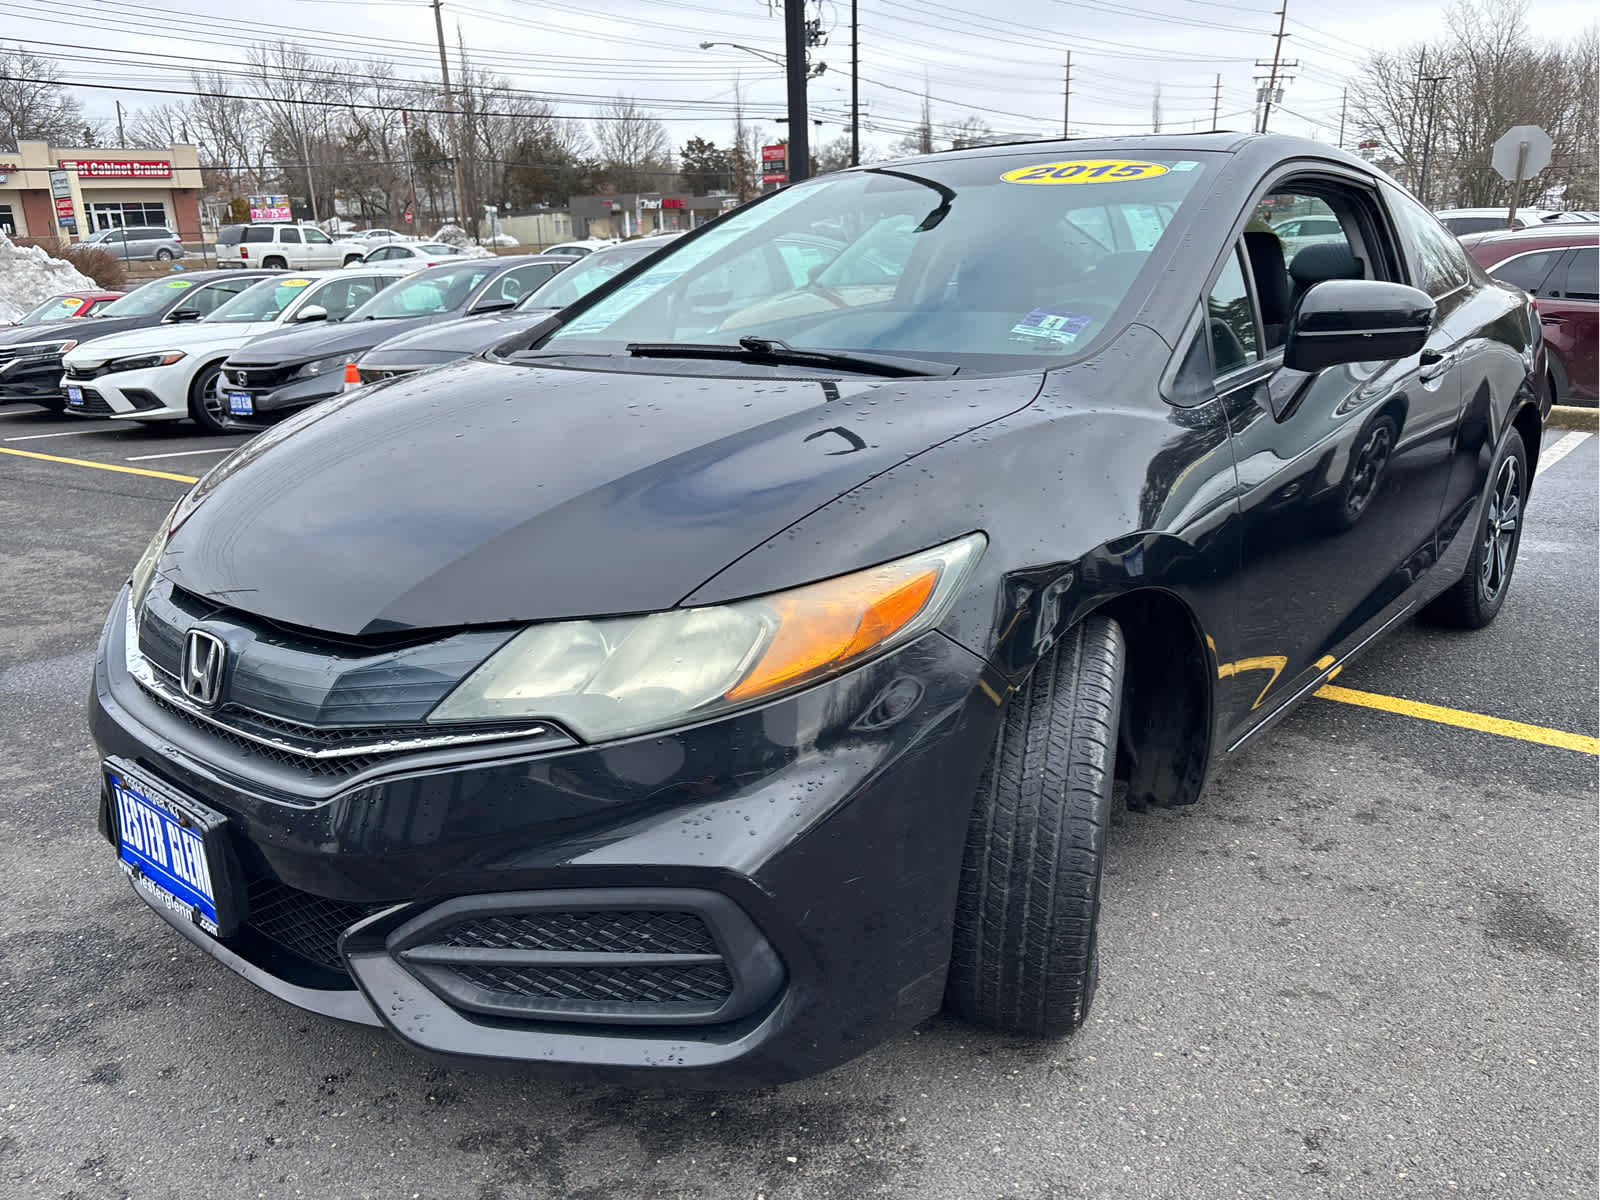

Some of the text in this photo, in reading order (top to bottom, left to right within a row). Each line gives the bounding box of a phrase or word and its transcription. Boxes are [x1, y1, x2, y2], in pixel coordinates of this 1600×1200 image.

[91, 162, 132, 175] Cabinet
[133, 162, 169, 175] Brands
[1015, 164, 1152, 181] 2015
[114, 788, 168, 868] LESTER
[138, 871, 193, 921] lesterglenn
